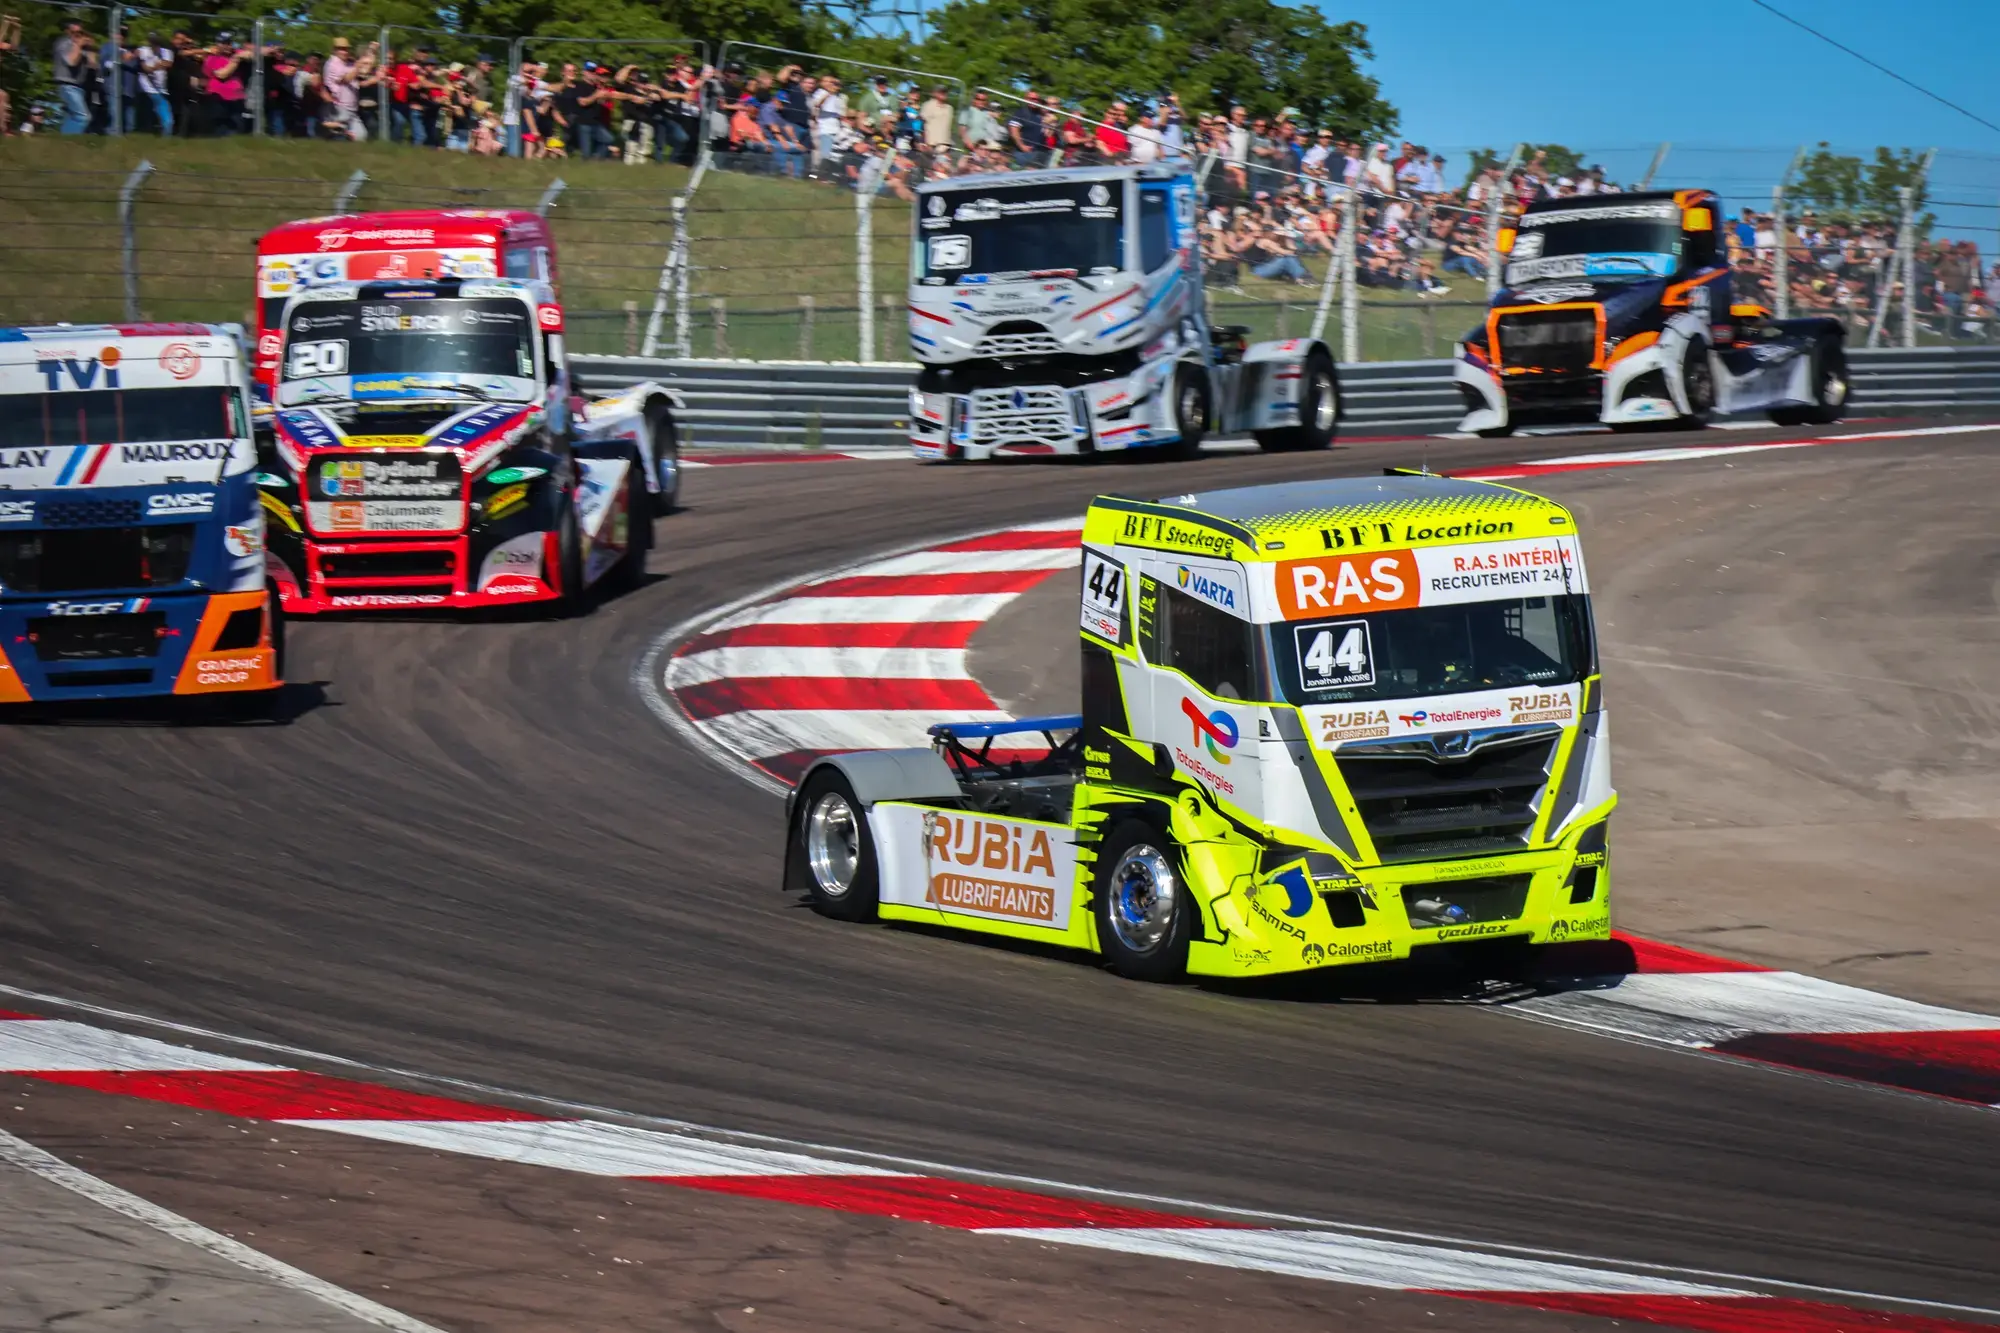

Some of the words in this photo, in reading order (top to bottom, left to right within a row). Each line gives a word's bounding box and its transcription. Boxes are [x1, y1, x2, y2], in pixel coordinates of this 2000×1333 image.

[292, 342, 347, 374] 20
[121, 443, 236, 463] MAUROUX
[1123, 515, 1167, 542] BFT
[1166, 526, 1234, 553] Stockage
[1320, 522, 1394, 550] BFT
[1405, 519, 1514, 541] Location
[1503, 546, 1572, 568] INTÉRIM
[1089, 563, 1121, 609] 44
[1192, 572, 1235, 609] VARTA
[1432, 569, 1539, 591] RECRUTEMENT
[1304, 627, 1367, 678] 44
[198, 672, 249, 684] GROUP
[1306, 676, 1342, 686] Jonathan
[1343, 672, 1371, 682] ANDRÉ
[1429, 708, 1502, 723] TotalEnergies
[1519, 711, 1571, 722] LUBRIFIANTS
[1331, 728, 1388, 740] LUBRIFIANTS
[1175, 747, 1234, 794] TotalEnergies
[942, 878, 1050, 915] LUBRIFIANTS
[1251, 900, 1307, 942] SAMPA
[1327, 939, 1393, 956] Calorstat
